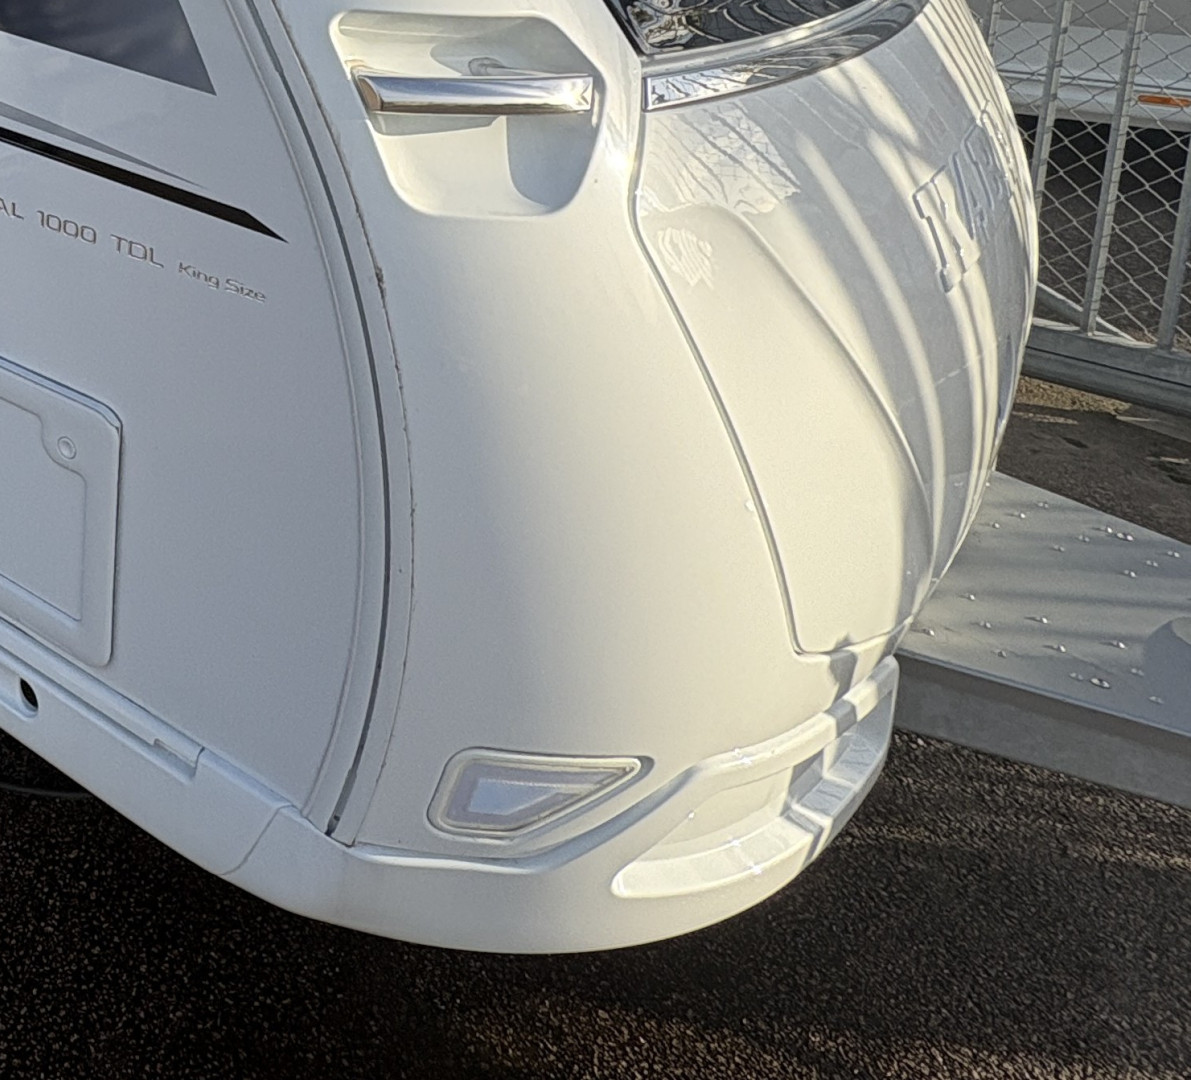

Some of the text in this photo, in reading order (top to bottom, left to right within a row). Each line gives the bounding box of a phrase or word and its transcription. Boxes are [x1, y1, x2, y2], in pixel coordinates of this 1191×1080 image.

[37, 210, 97, 244] 1000
[111, 234, 164, 268] TDL
[178, 262, 219, 289] King
[224, 278, 266, 302] Size
